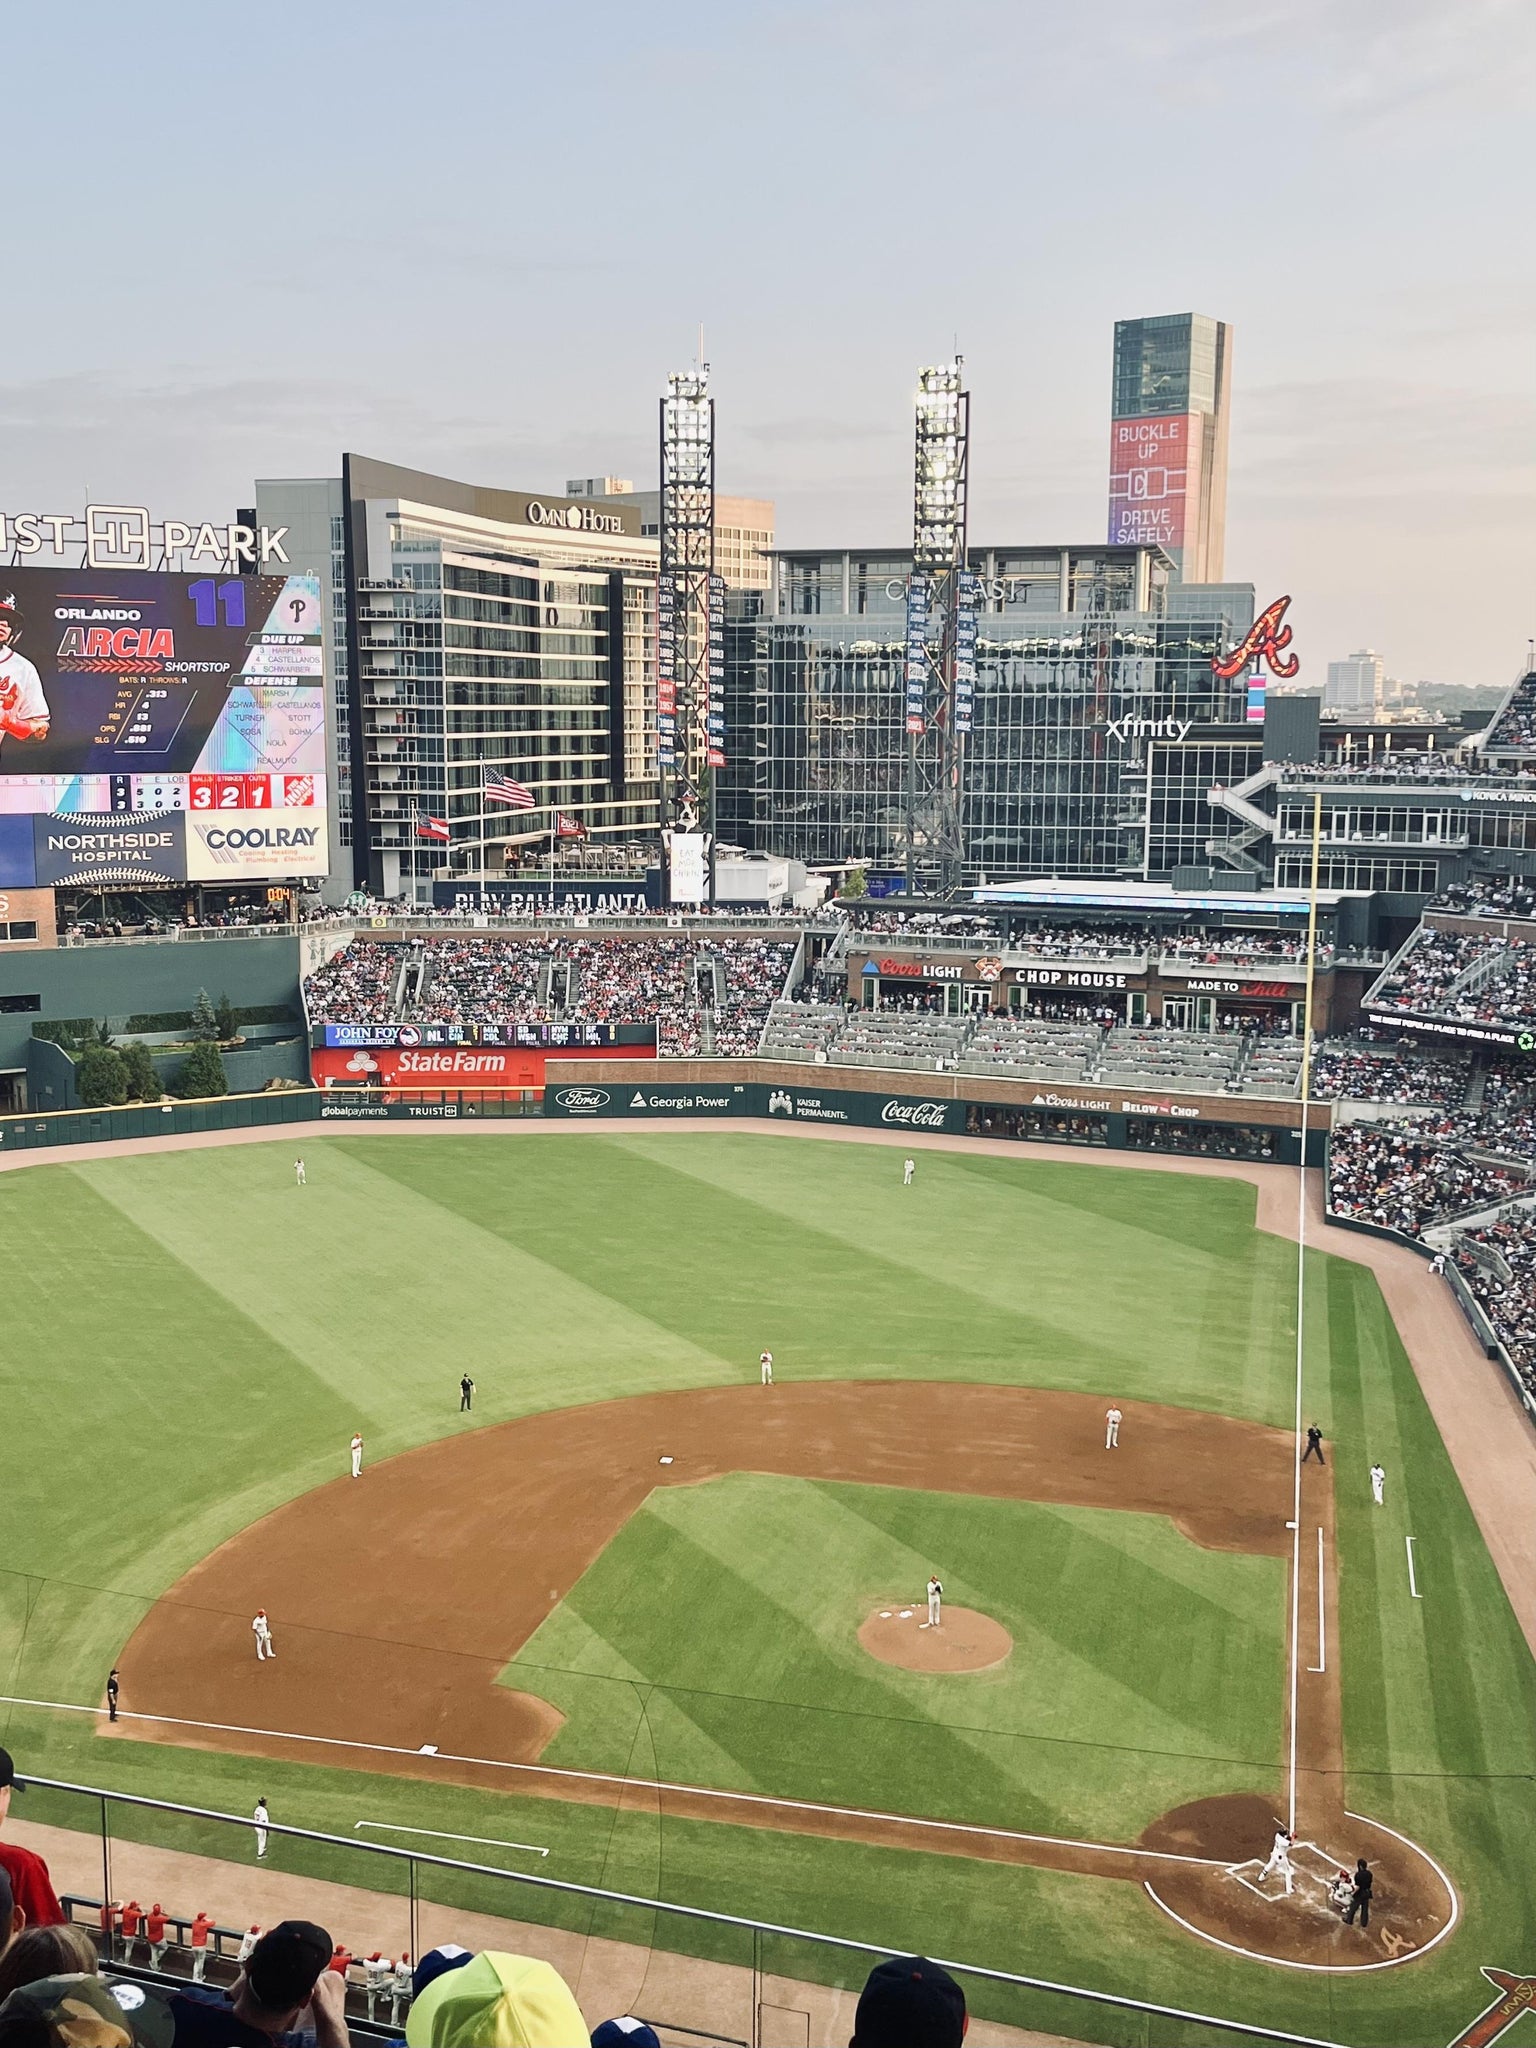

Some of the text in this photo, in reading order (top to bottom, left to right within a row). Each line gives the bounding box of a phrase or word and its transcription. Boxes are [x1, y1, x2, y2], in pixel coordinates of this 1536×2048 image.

[1119, 422, 1180, 443] BUCKLE
[1138, 443, 1159, 460] UP
[1121, 508, 1170, 526] DRIVE
[1117, 526, 1175, 544] SAFELY
[163, 521, 292, 563] PARK
[188, 579, 246, 626] 11
[54, 608, 141, 621] ORLANDO
[57, 627, 175, 658] ARCIA
[261, 635, 304, 644] DUE UP
[268, 656, 320, 664] CASTELLANOS
[165, 662, 231, 672] SHORTSTOP
[244, 676, 298, 686] DEFENSE
[145, 690, 167, 698] .313
[227, 701, 321, 709] SCHWARBER CASTELLANOS
[289, 728, 312, 736] BOHM
[1105, 713, 1193, 743] xfinity
[257, 757, 297, 765] REALMUTO
[116, 776, 124, 784] R
[116, 788, 126, 797] 3
[193, 786, 264, 808] 3 2 1
[1473, 791, 1507, 802] KONICA
[117, 801, 126, 810] 3
[173, 800, 181, 808] 0
[561, 817, 579, 829] 2021
[49, 832, 173, 850] NORTHSIDE
[207, 827, 320, 849] COOLRAY
[72, 851, 152, 863] HOSPITAL
[267, 888, 290, 901] 0:04
[559, 893, 647, 911] ATLANTA
[879, 958, 963, 979] Coors LIGHT
[1015, 969, 1127, 988] CHOP HOUSE
[1188, 980, 1221, 991] MADE
[1223, 982, 1239, 991] TO
[335, 1027, 401, 1039] JOHN FOY
[473, 1025, 478, 1033] 2
[507, 1025, 513, 1033] 6
[427, 1030, 444, 1042] NL
[586, 1033, 601, 1041] MIL
[565, 1090, 600, 1106] Ford
[650, 1096, 730, 1109] Georgia Power
[797, 1098, 821, 1107] KAISER
[1045, 1094, 1111, 1110] Coors LIGHT
[322, 1106, 444, 1117] globalpayments TRUIST
[797, 1107, 846, 1119] PERMANENTE
[1122, 1101, 1200, 1118] BELOW CHOP
